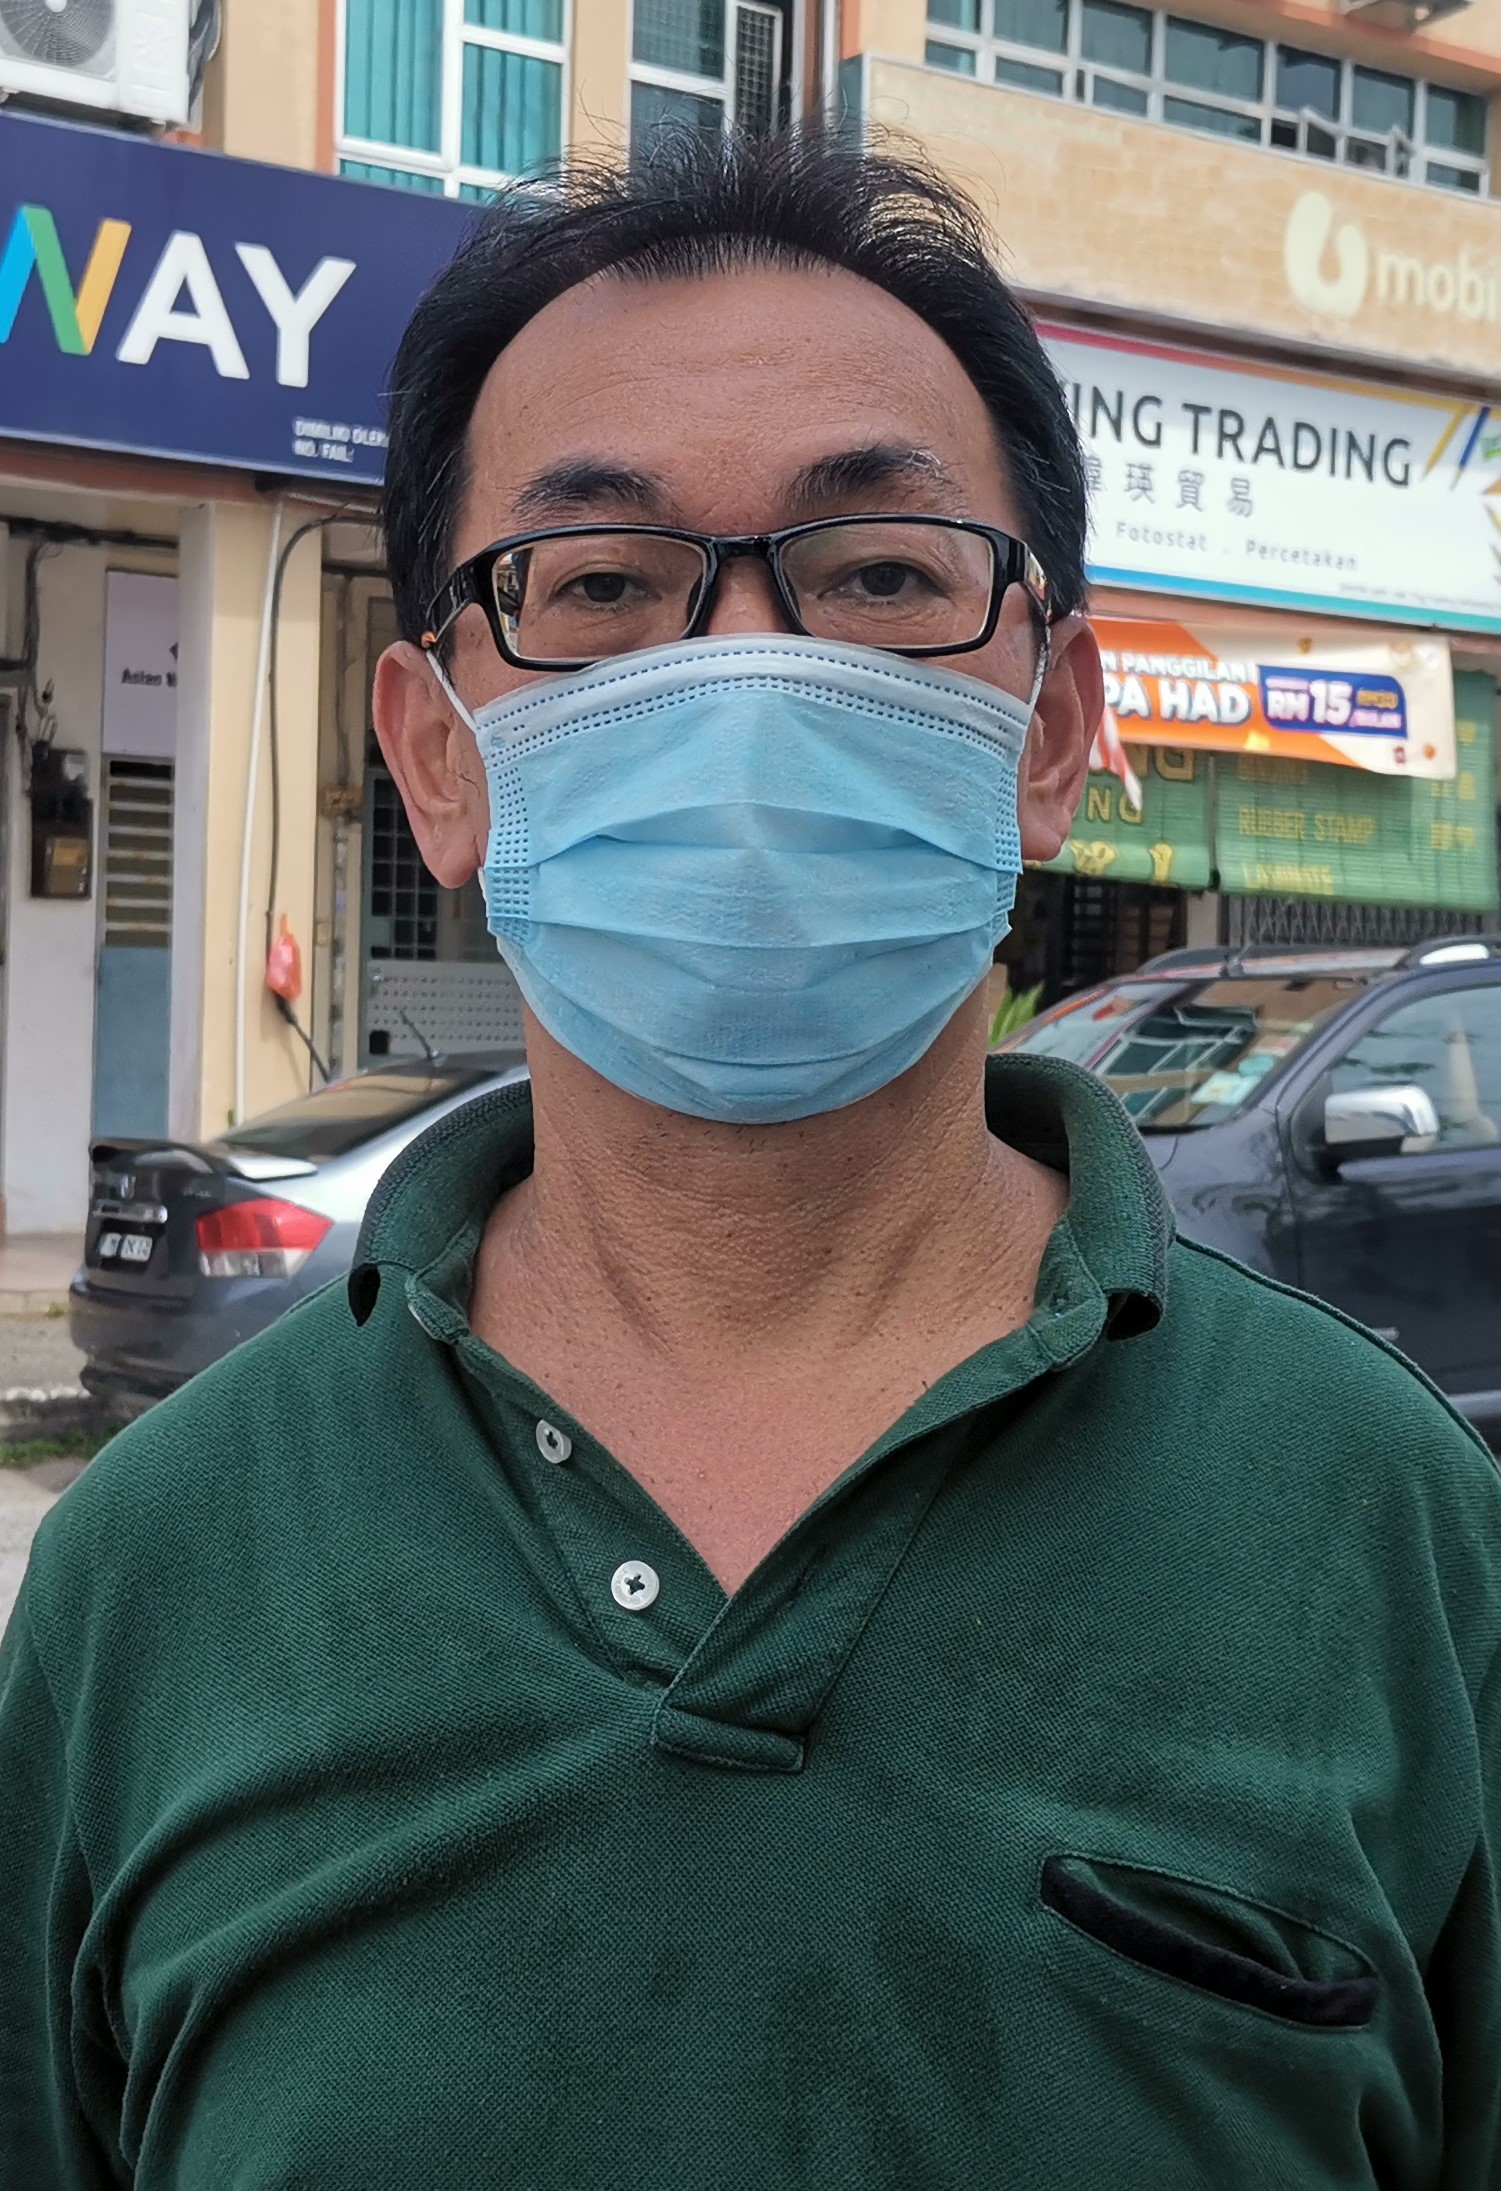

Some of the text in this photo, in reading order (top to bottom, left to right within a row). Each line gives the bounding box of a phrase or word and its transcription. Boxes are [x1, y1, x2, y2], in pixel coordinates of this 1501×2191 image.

[1060, 379, 1412, 487] ING TRADING
[1116, 520, 1359, 571] Fotostat Percetakan
[1122, 652, 1248, 683] PANGGILAN
[1158, 677, 1251, 726] HAD
